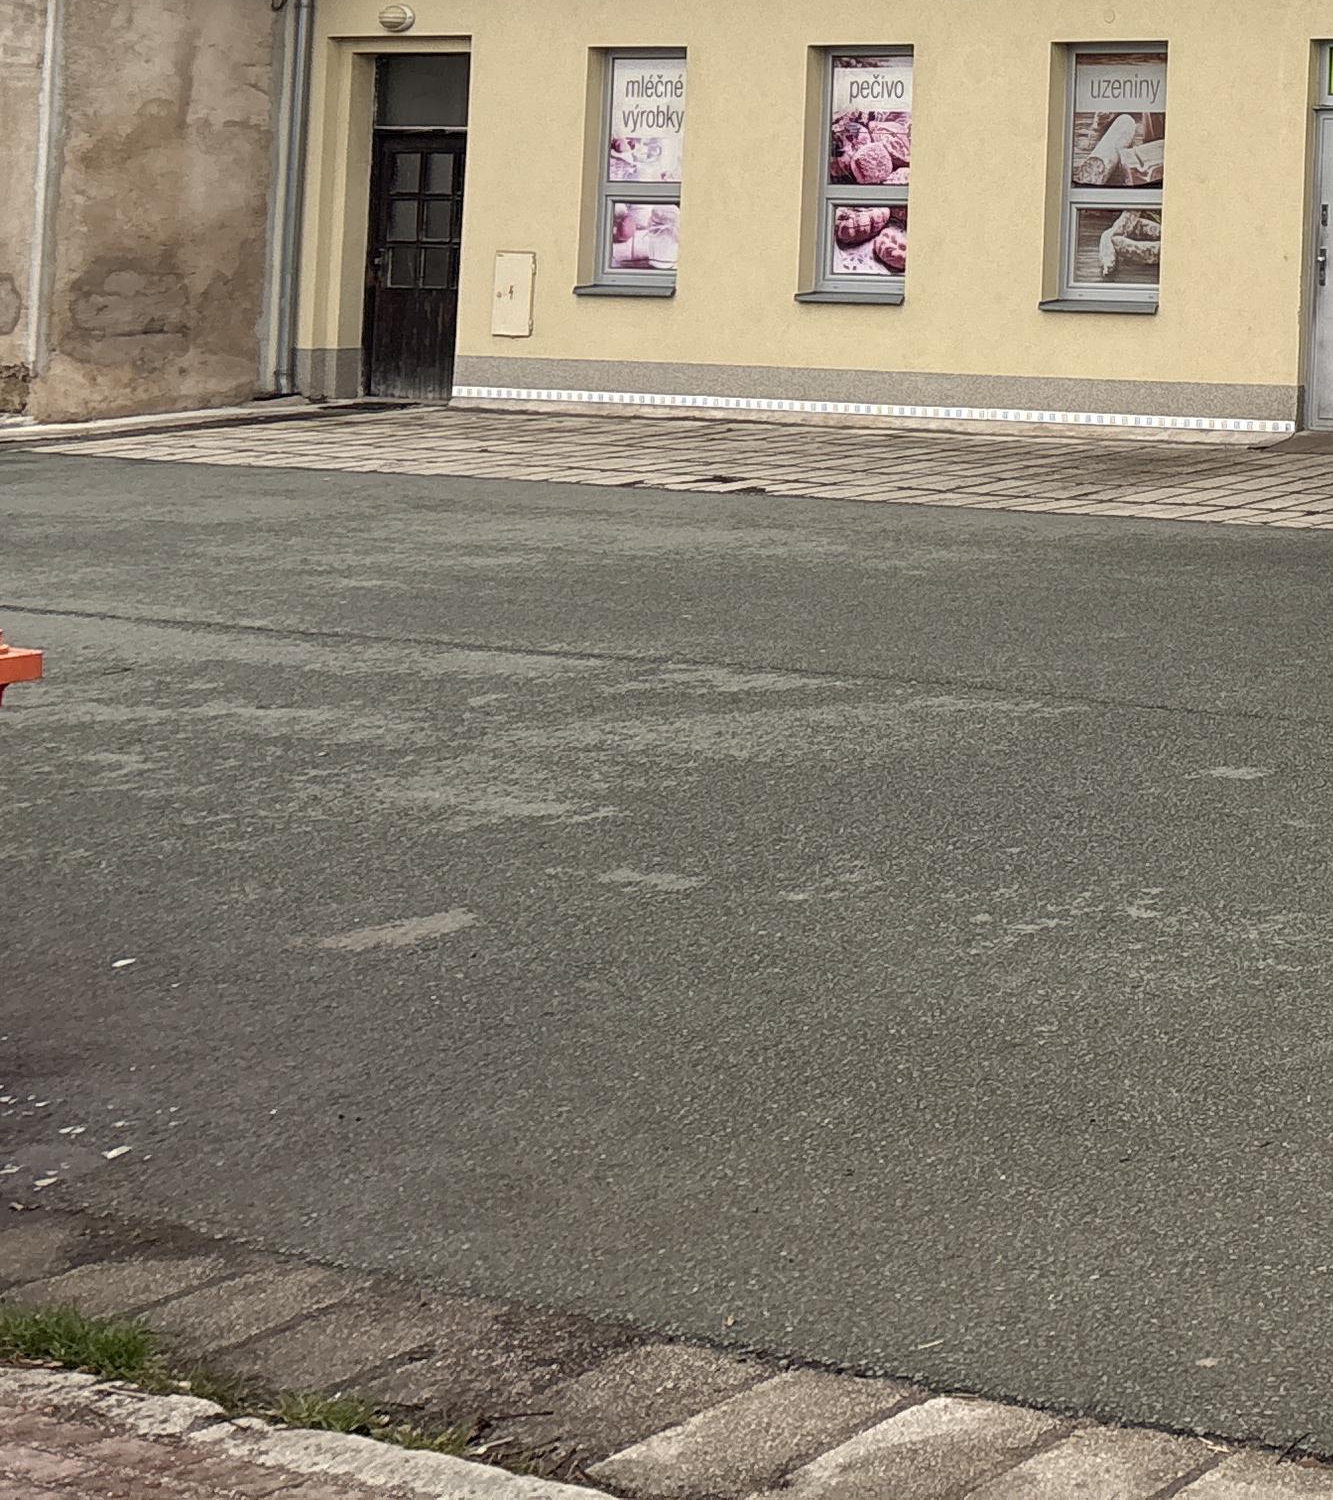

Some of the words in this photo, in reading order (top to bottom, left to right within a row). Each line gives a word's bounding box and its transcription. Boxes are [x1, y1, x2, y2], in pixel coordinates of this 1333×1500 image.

[625, 74, 684, 98] mléčné
[848, 75, 905, 104] pečivo
[1089, 75, 1160, 104] uzeniny
[622, 104, 685, 133] výrobky
